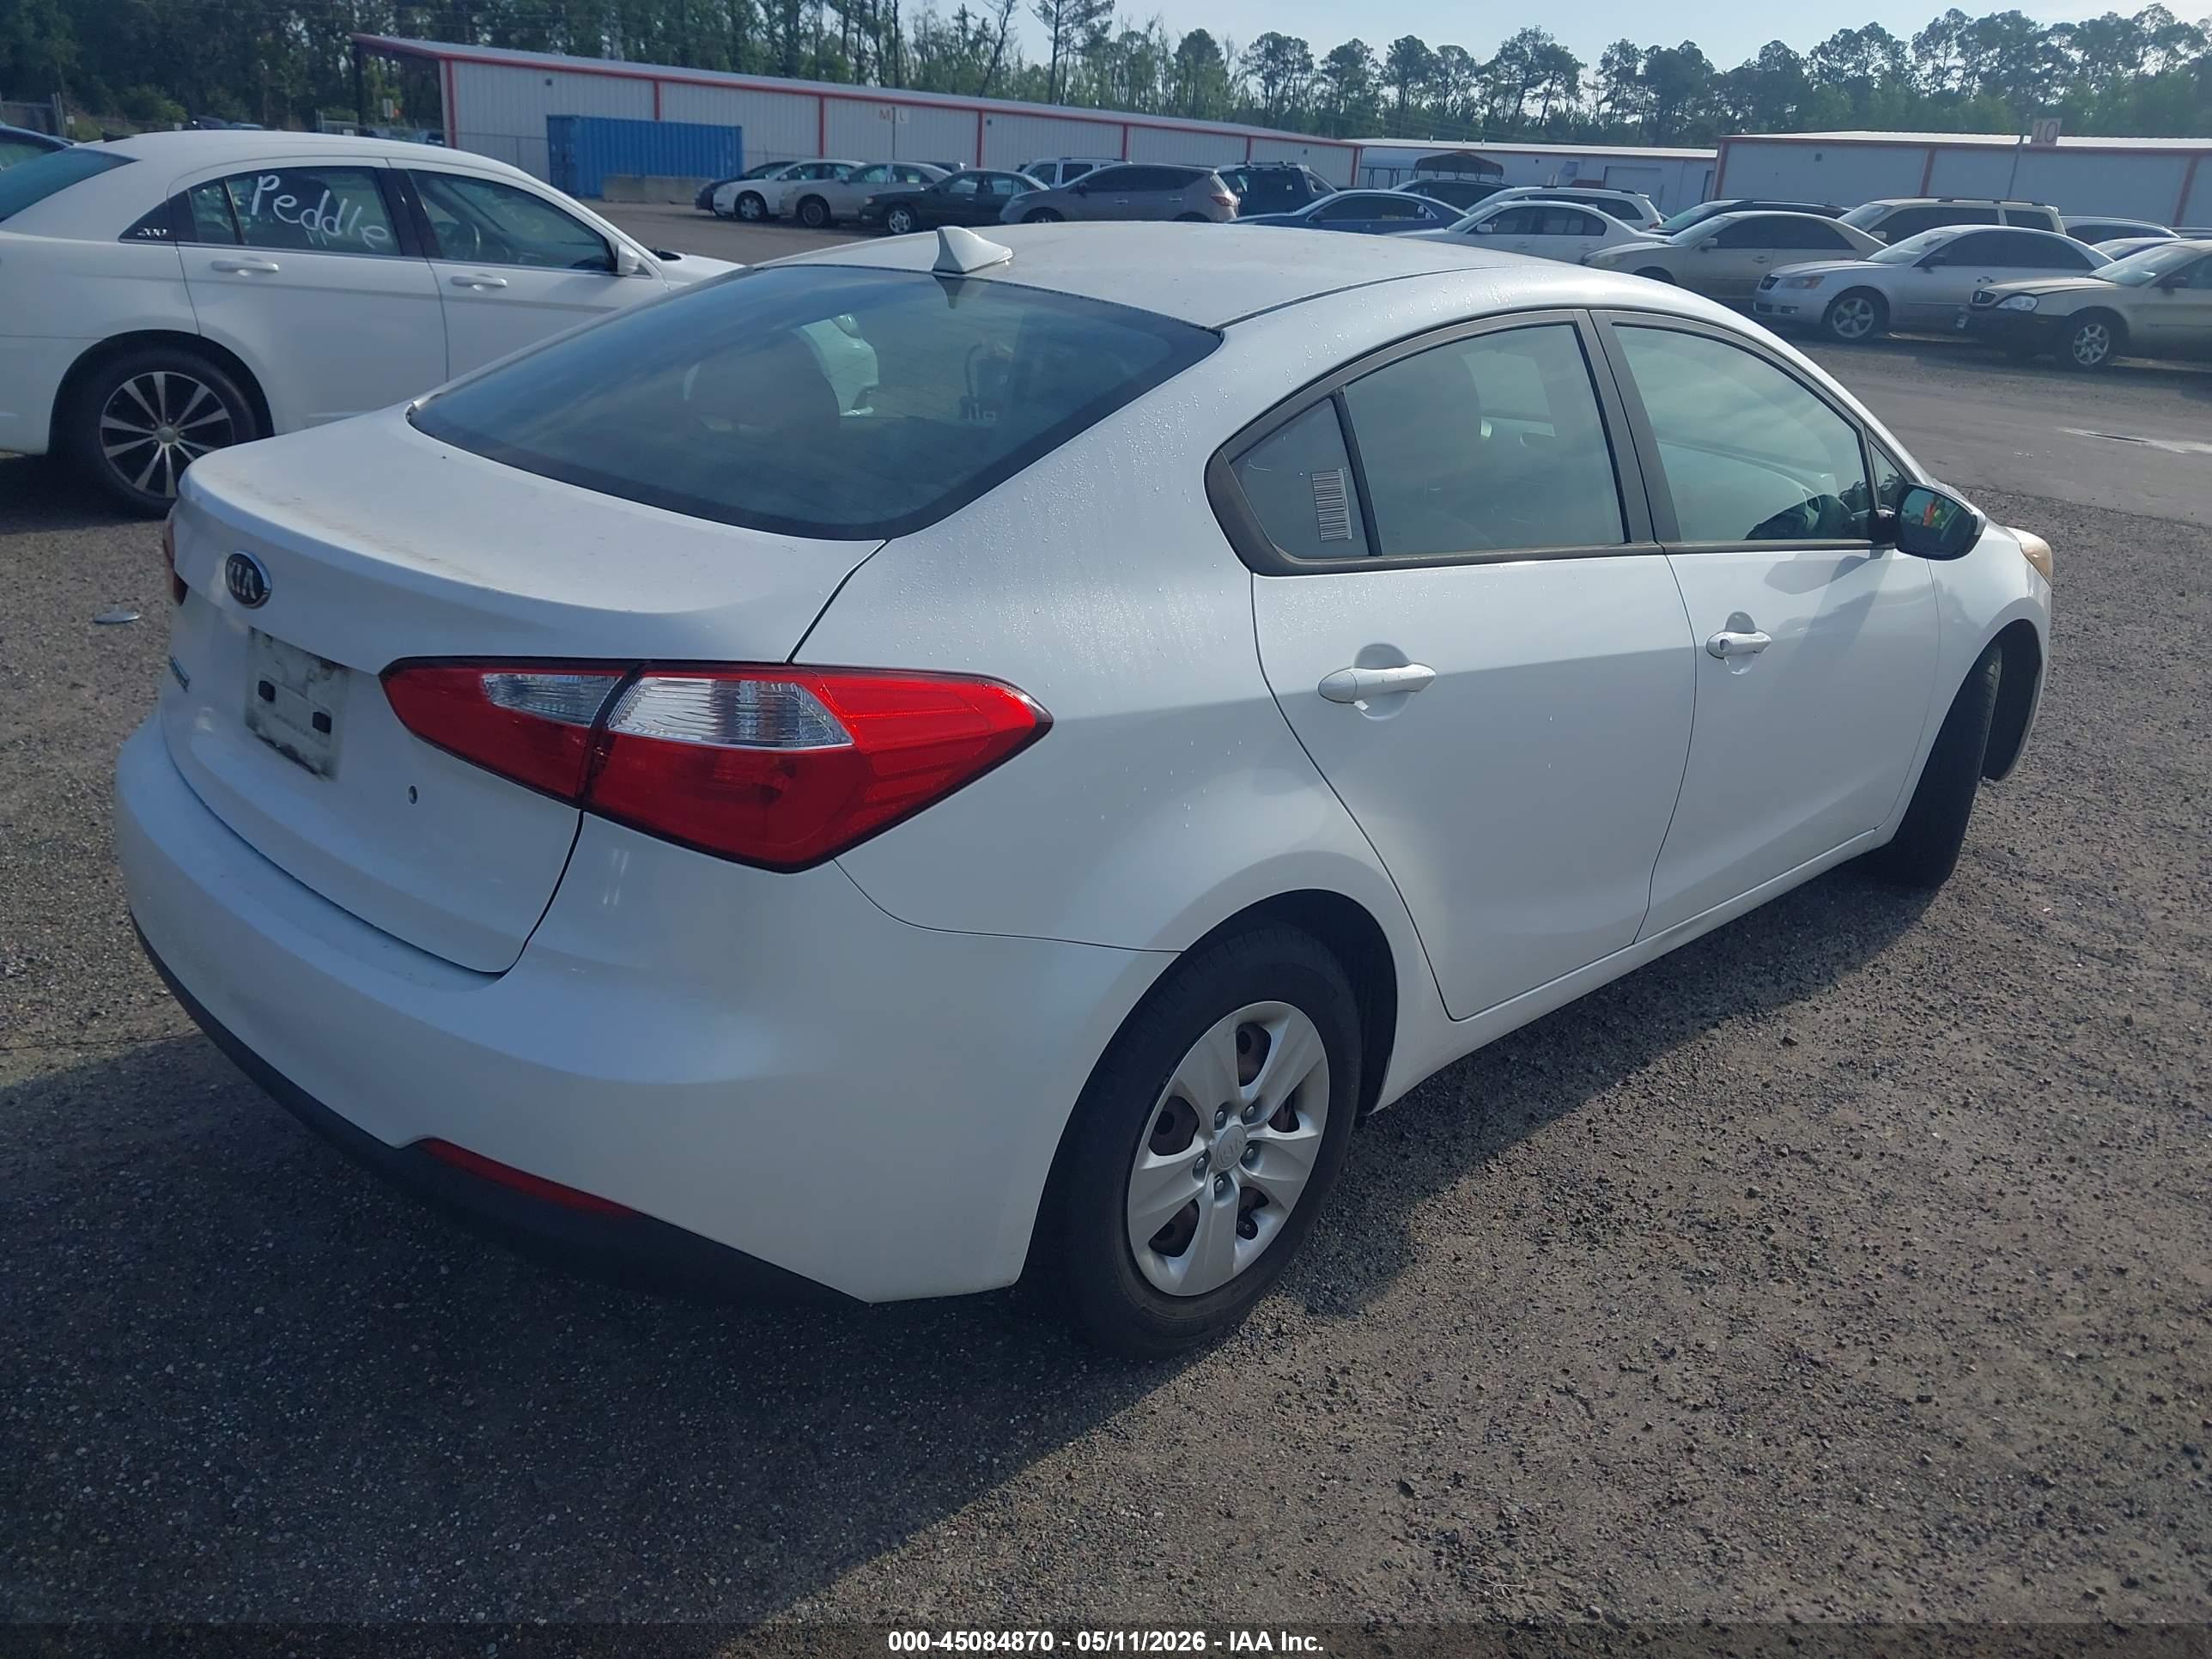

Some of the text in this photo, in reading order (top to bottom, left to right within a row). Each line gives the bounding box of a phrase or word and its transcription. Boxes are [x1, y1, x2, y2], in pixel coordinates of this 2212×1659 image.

[2035, 121, 2058, 143] 10
[251, 174, 389, 249] Peddle
[226, 559, 257, 599] KIA
